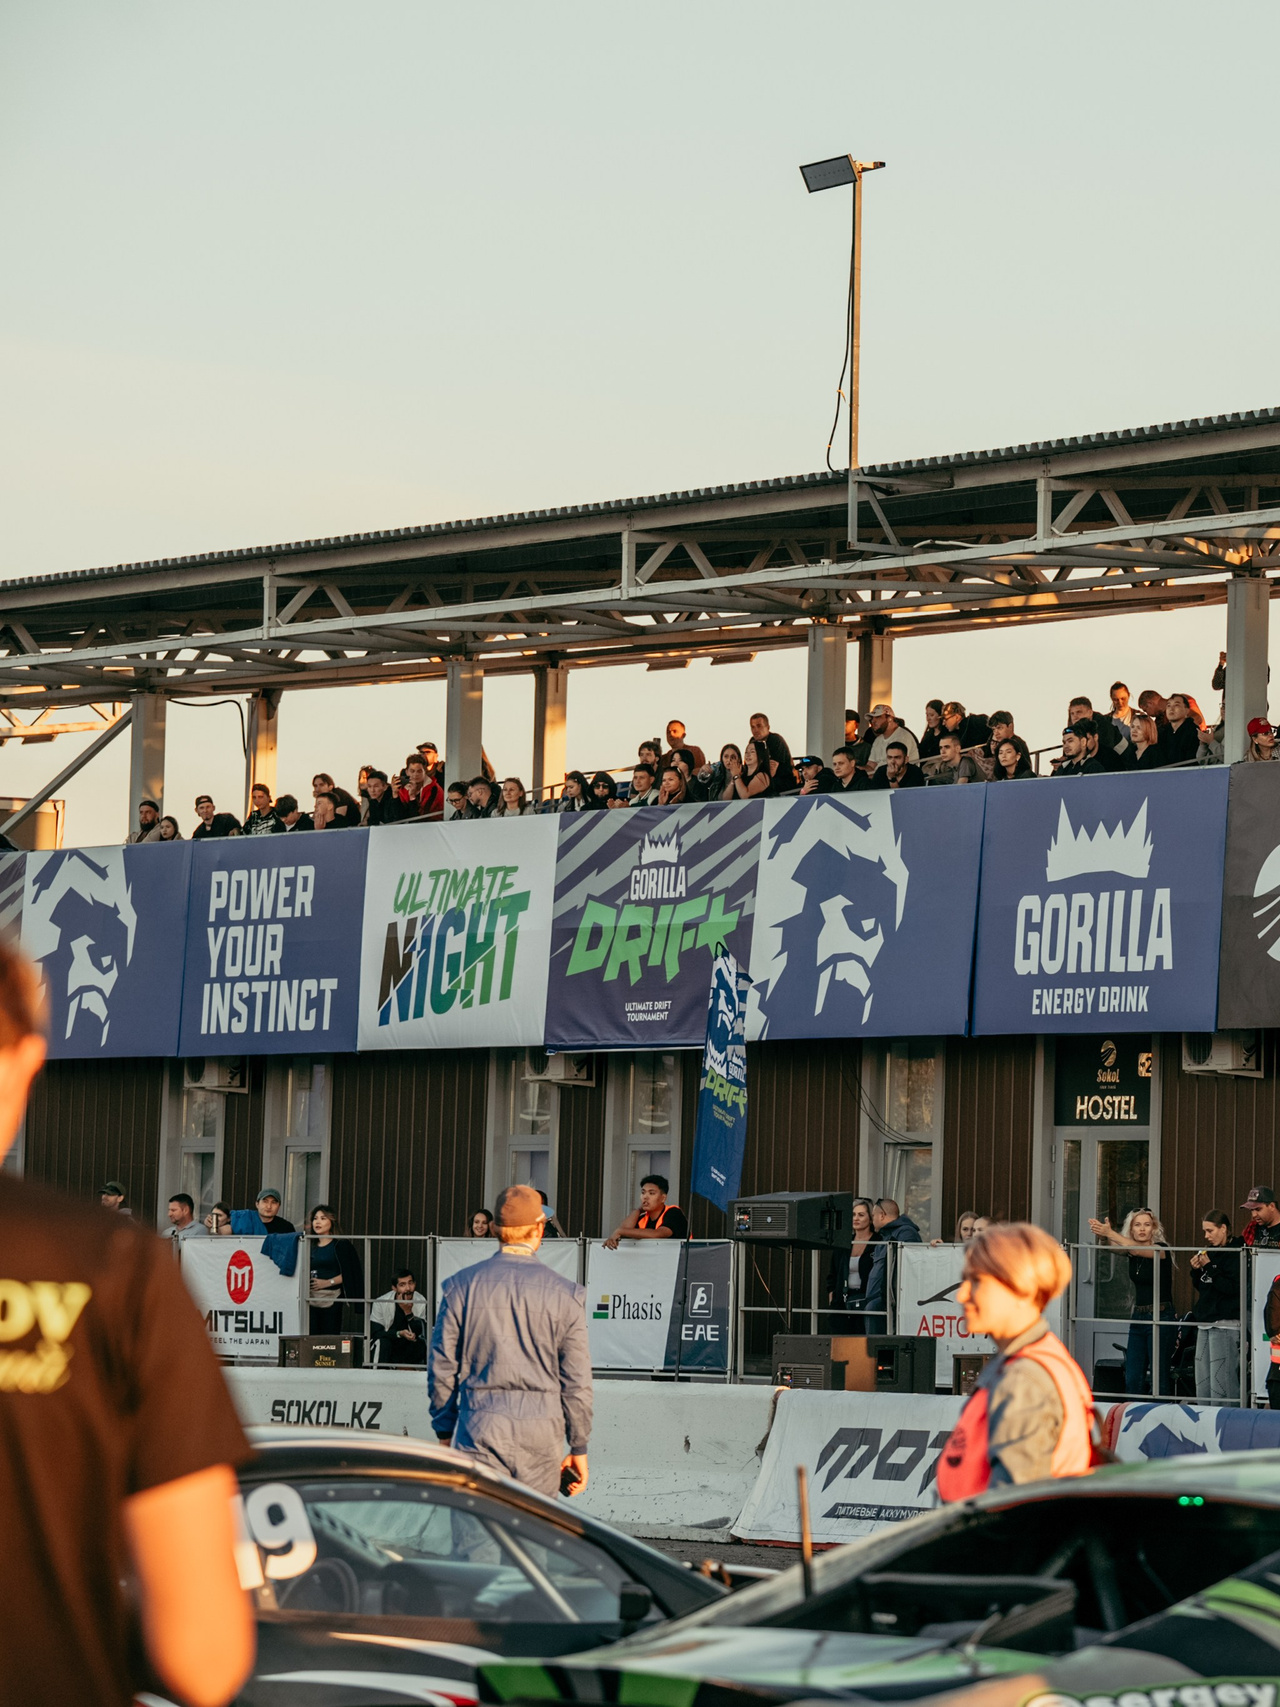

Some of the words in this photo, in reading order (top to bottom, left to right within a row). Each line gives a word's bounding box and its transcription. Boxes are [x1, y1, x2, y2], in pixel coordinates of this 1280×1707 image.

[208, 865, 315, 922] POWER
[394, 865, 519, 917] ULTIMATE
[630, 866, 686, 900] GORILLA
[1014, 888, 1173, 976] GORILLA
[207, 924, 284, 978] YOUR
[378, 890, 531, 1027] NIGHT
[201, 979, 338, 1035] INSTINCT
[625, 1001, 652, 1012] ULTIMATE
[654, 1000, 672, 1011] DRIFT
[1031, 987, 1096, 1015] ENERGY
[1098, 986, 1149, 1014] DRINK
[626, 1011, 669, 1022] TOURNAMENT
[1075, 1095, 1137, 1120] HOSTEL
[611, 1294, 662, 1320] Phasis
[681, 1324, 719, 1341] EAE
[271, 1399, 383, 1430] SOKOL.KZ
[835, 1506, 877, 1518] ЛИТИЕВЫЕ
